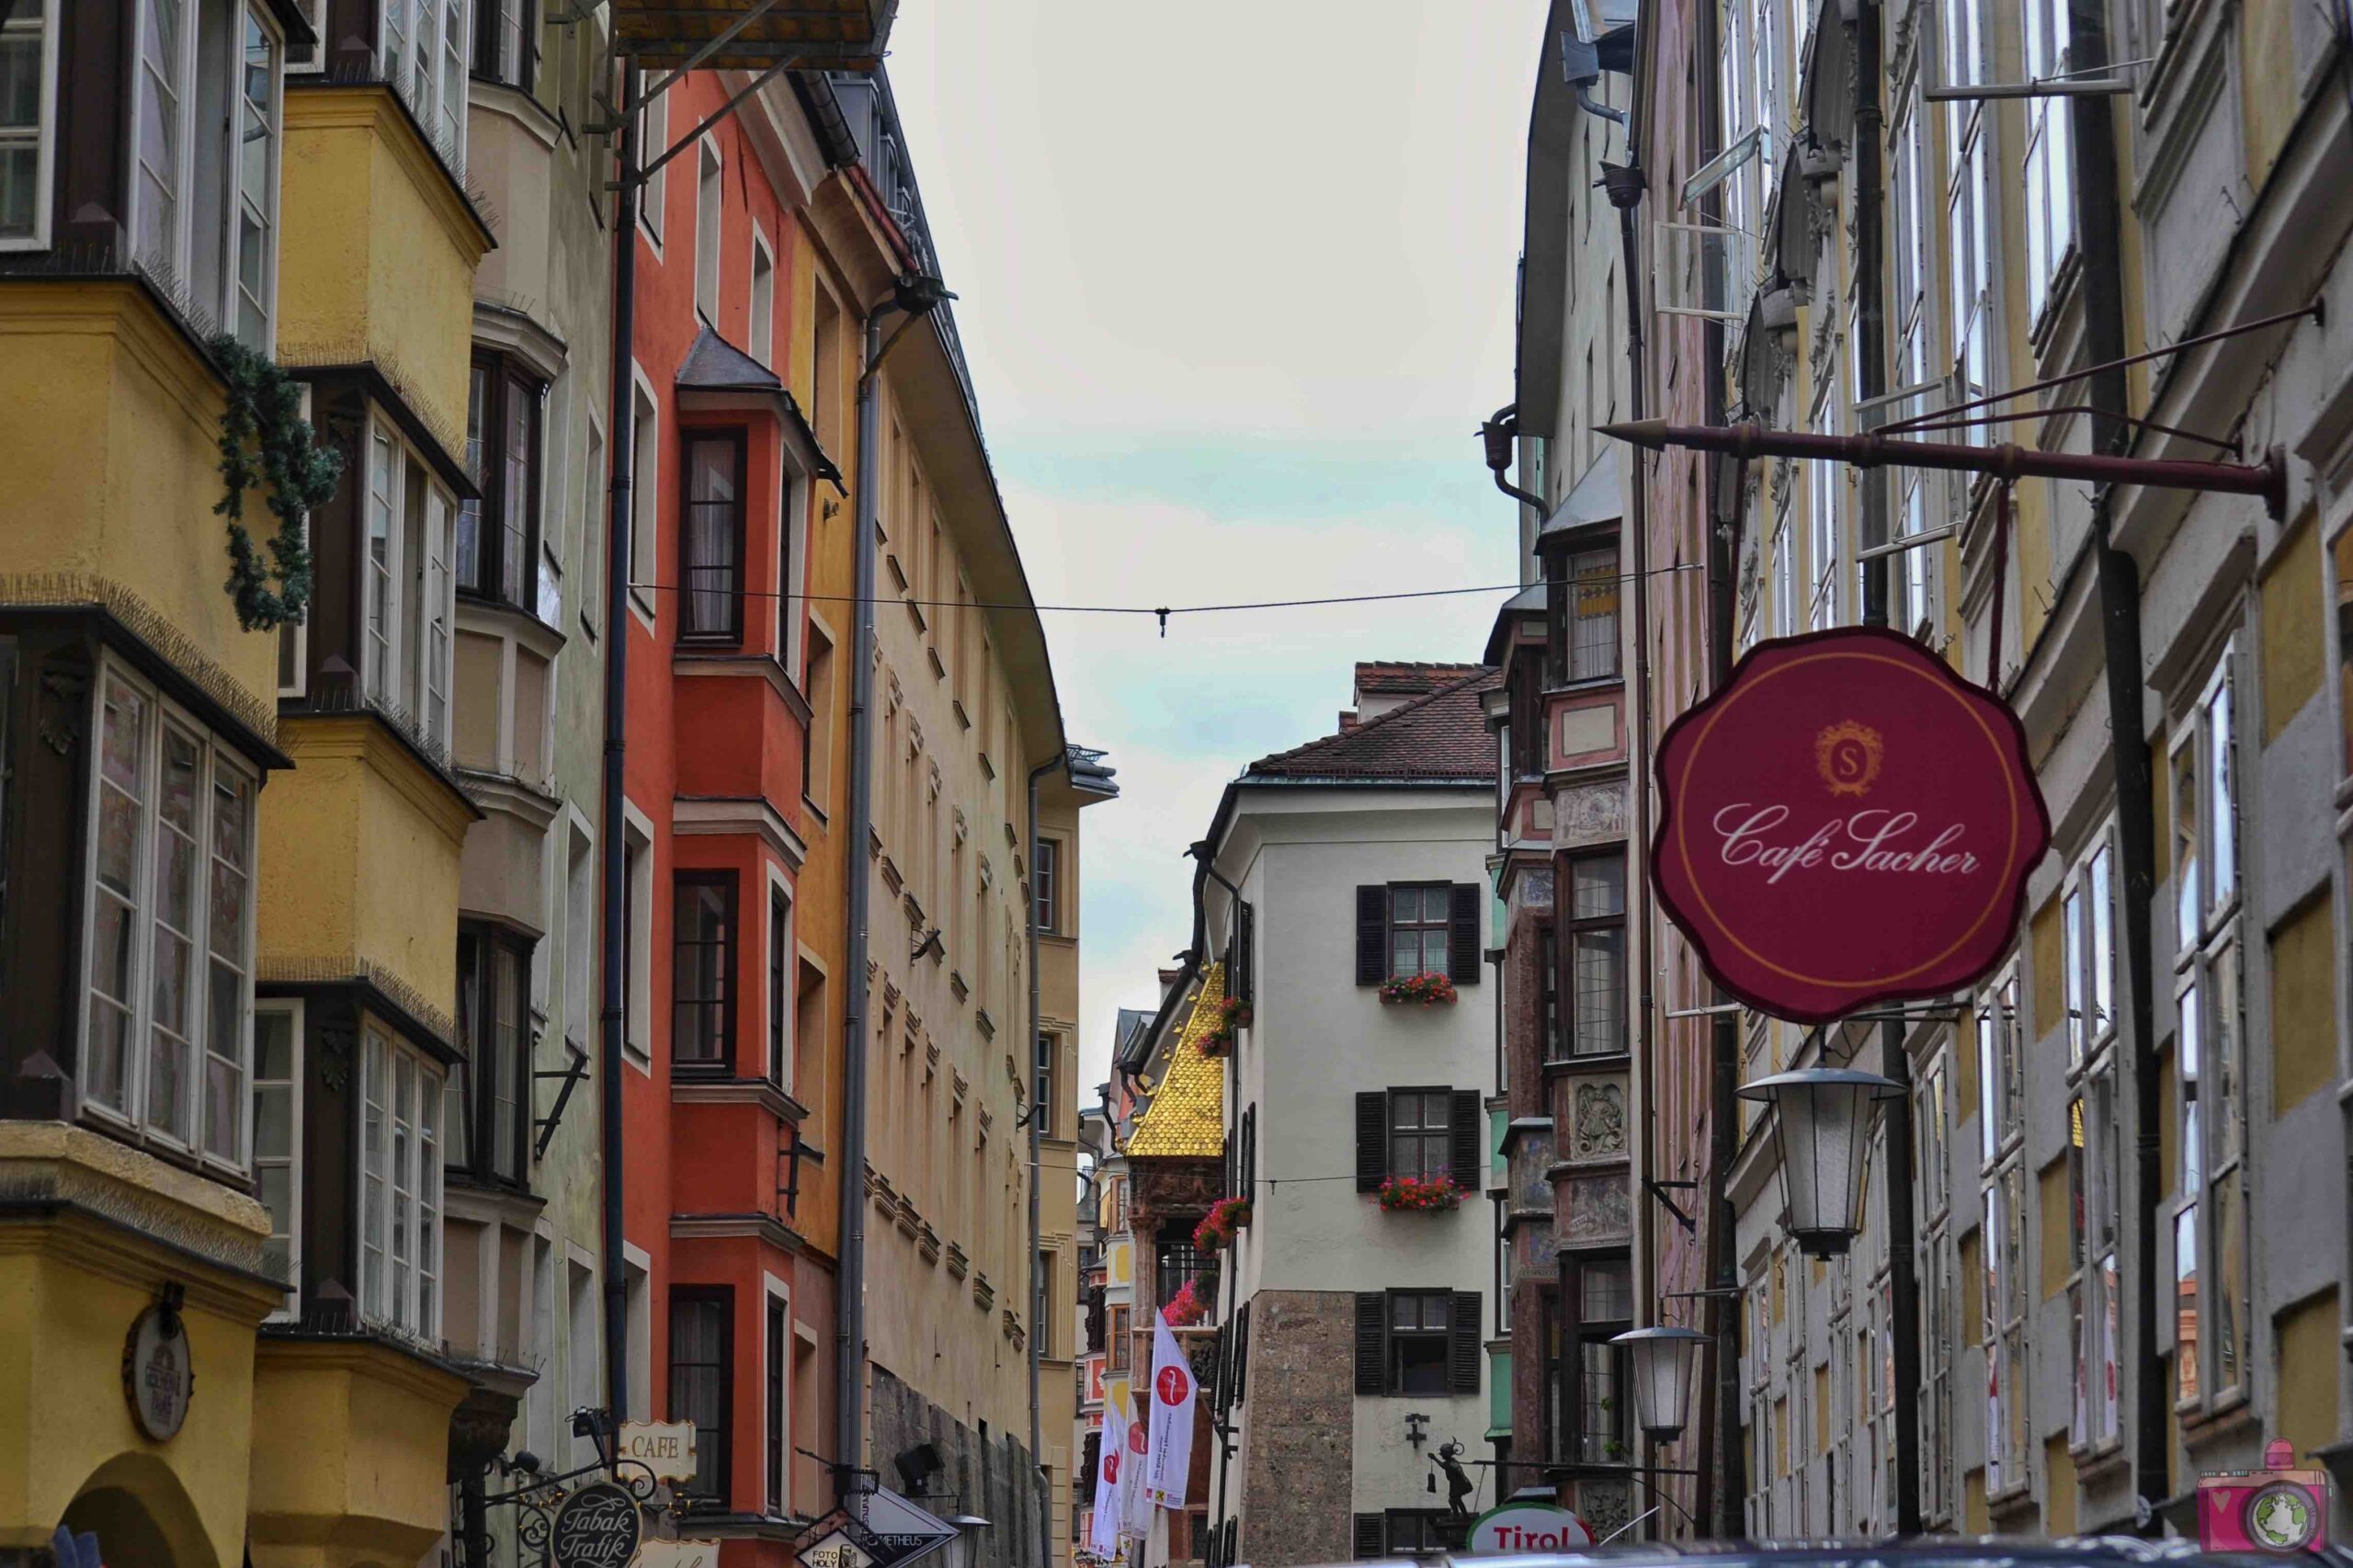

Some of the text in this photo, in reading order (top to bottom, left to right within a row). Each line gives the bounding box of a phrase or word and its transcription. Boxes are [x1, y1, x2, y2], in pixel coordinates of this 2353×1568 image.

[1840, 746, 1858, 776] S
[1713, 803, 1980, 884] Café Sacher
[631, 1436, 679, 1459] CAFE
[561, 1507, 635, 1533] Tabak
[558, 1533, 631, 1560] Trafik
[1494, 1526, 1569, 1551] Tirol
[812, 1559, 837, 1568] HOLY
[813, 1550, 838, 1560] FOTO
